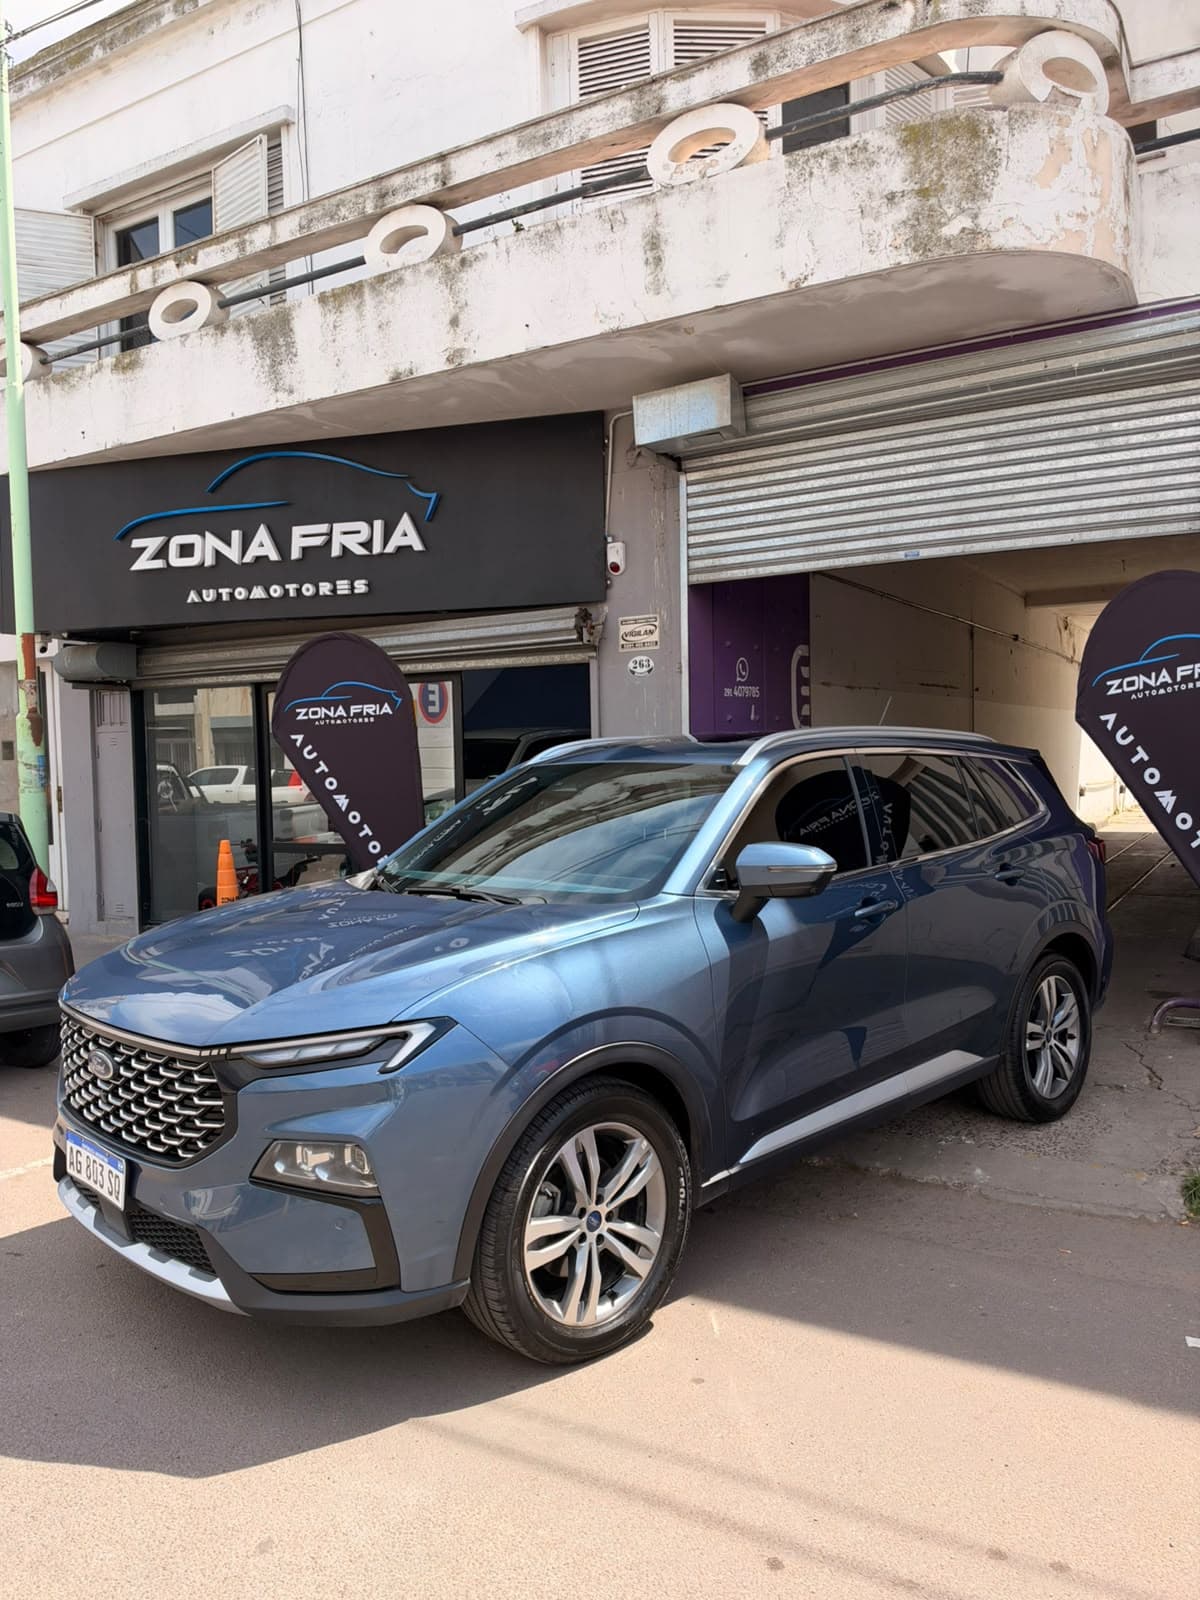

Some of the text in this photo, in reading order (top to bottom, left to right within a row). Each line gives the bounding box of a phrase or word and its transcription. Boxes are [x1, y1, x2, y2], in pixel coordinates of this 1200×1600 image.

[129, 511, 426, 571] ZONA FRIA
[186, 578, 369, 603] AUTOMOTORES
[632, 659, 651, 669] 263
[1106, 667, 1173, 696] ZONA
[296, 702, 393, 720] ZONA FRIA
[69, 1146, 82, 1175] AG
[86, 1155, 104, 1189] 803
[108, 1169, 120, 1201] SQ
